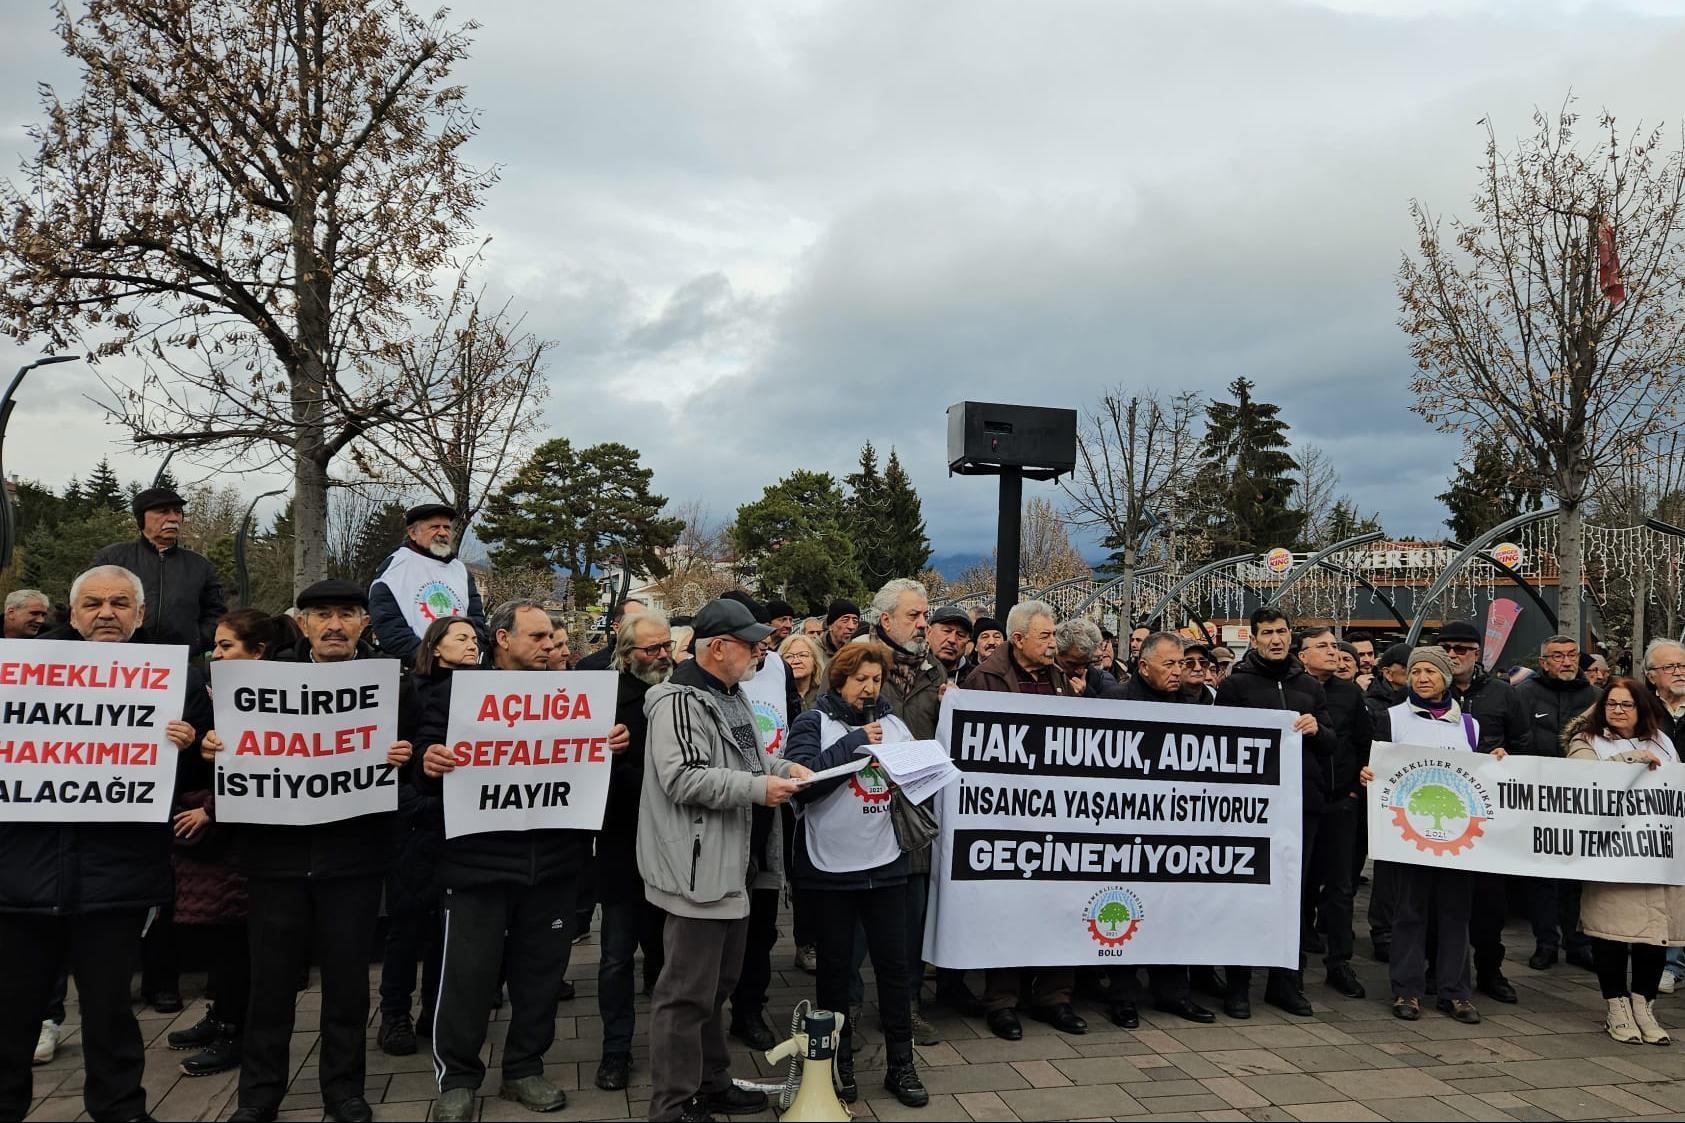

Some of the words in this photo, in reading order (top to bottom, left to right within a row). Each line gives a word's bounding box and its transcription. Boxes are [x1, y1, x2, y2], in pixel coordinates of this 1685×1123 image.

[1270, 558, 1289, 566] KING
[0, 661, 171, 690] EMEKLİYİZ
[3, 701, 156, 727] HAKLIYIZ
[234, 684, 380, 715] GELİRDE
[477, 688, 592, 729] AÇLIĞA
[0, 740, 158, 765] HAKKIMIZI
[235, 725, 378, 757] ADALET
[453, 737, 607, 768] SEFALETE
[961, 722, 1036, 769] HAK,
[1044, 726, 1150, 775] HUKUK,
[1158, 732, 1272, 774] ADALET
[217, 762, 396, 799] İSTİYORUZ
[1389, 759, 1452, 784] EMEKLİLER
[0, 776, 156, 804] ALACAĞIZ
[479, 781, 571, 811] HAYIR
[958, 778, 1057, 817] İNSANCA
[1063, 790, 1166, 826] YAŞAMAK
[1170, 788, 1270, 824] İSTİYORUZ
[1497, 779, 1534, 811] TÜM
[1538, 782, 1624, 817] EMEKLİLER
[1626, 782, 1685, 818] SENDİKA
[1425, 830, 1446, 838] 2021
[1533, 826, 1574, 856] BOLU
[1579, 824, 1674, 859] TEMSİLCİLİĞİ
[968, 834, 1256, 878] GEÇİNEMİYORUZ
[1098, 949, 1123, 957] BOLU
